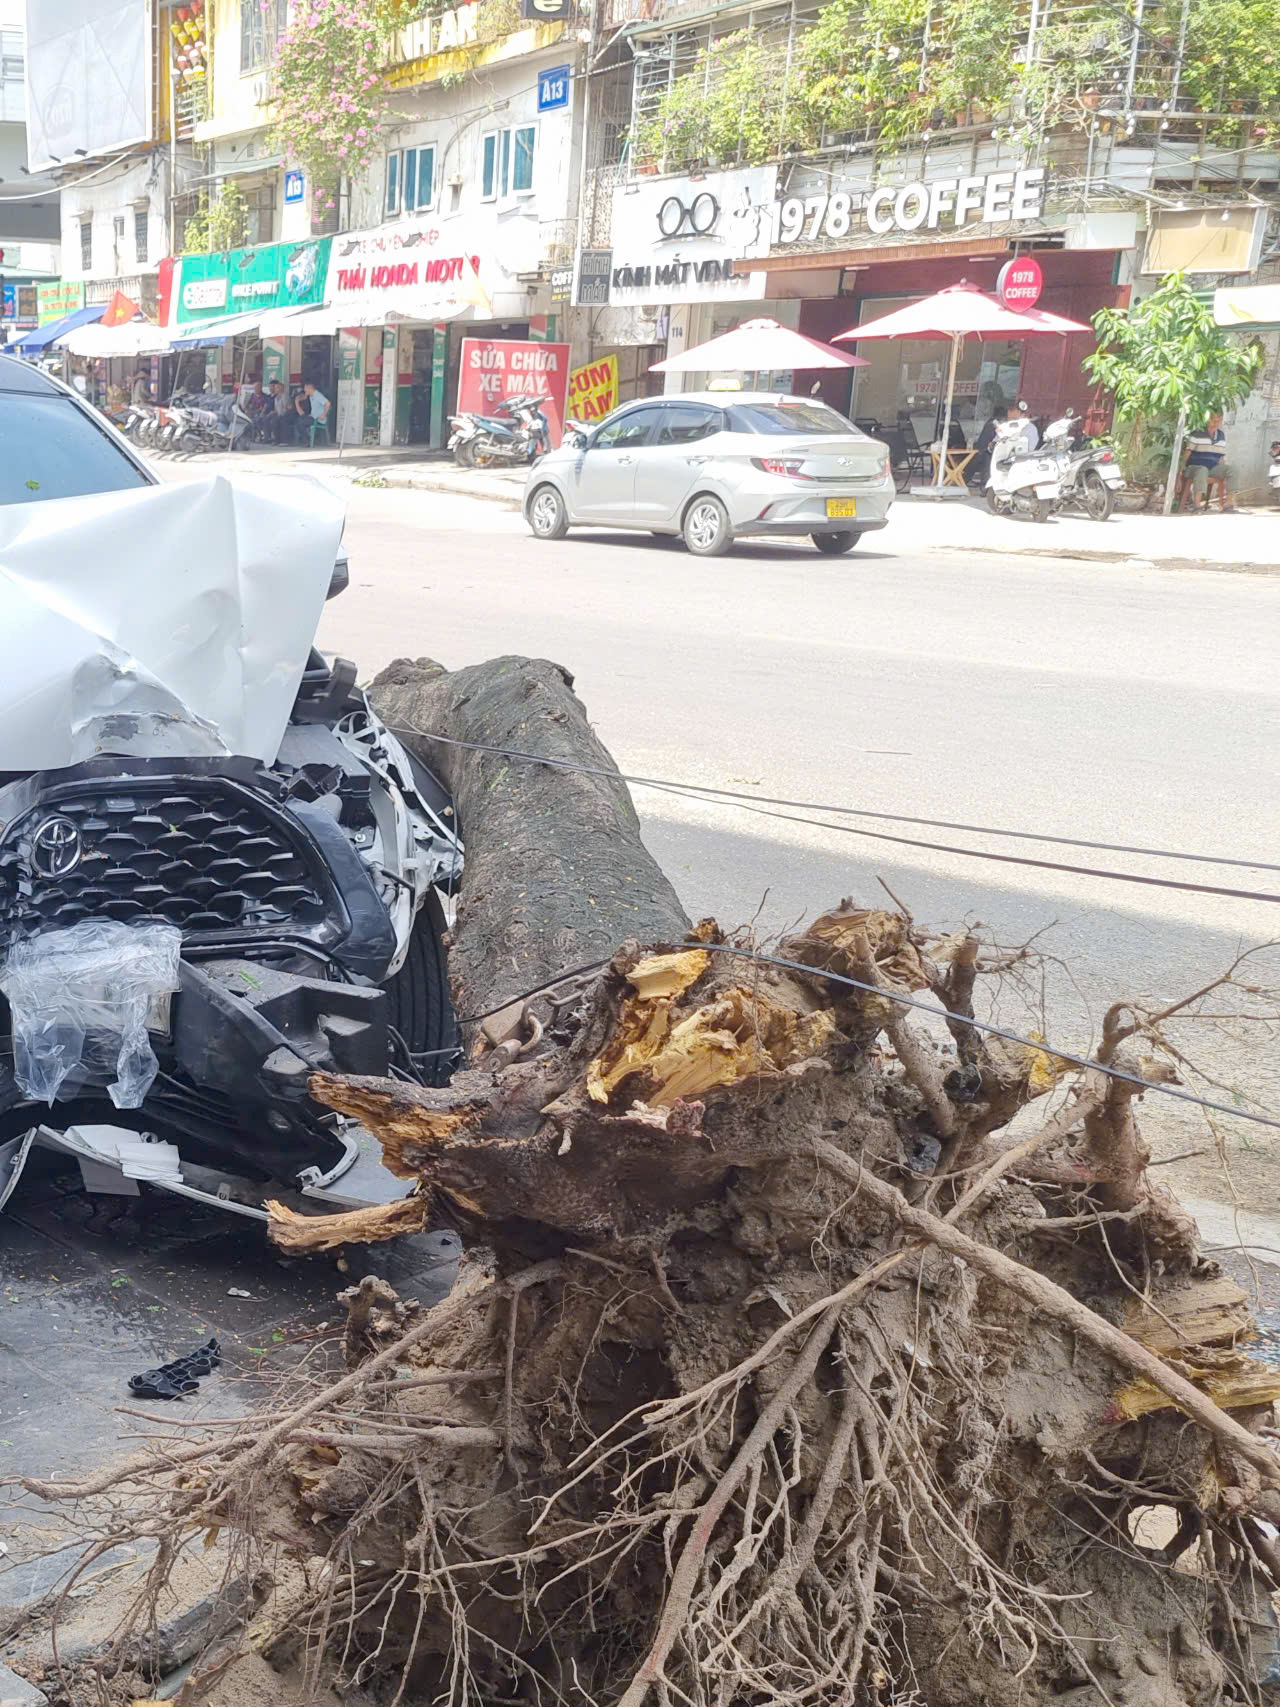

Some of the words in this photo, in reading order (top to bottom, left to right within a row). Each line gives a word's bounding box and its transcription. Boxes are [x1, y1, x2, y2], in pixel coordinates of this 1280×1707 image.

[541, 80, 564, 104] A13
[287, 179, 302, 197] A13
[771, 192, 852, 244] 1978
[867, 168, 1044, 234] COFFEE
[370, 262, 418, 288] HONDA
[612, 262, 651, 288] KÍNH
[655, 253, 691, 286] MẮT
[1012, 271, 1034, 283] 1978
[1005, 287, 1038, 299] COFFEE
[470, 344, 505, 369] SỬA
[511, 349, 558, 371] CHỮA
[478, 374, 501, 392] XE
[507, 372, 548, 394] MÁY
[916, 383, 937, 393] 1978
[570, 390, 613, 420] TẤM
